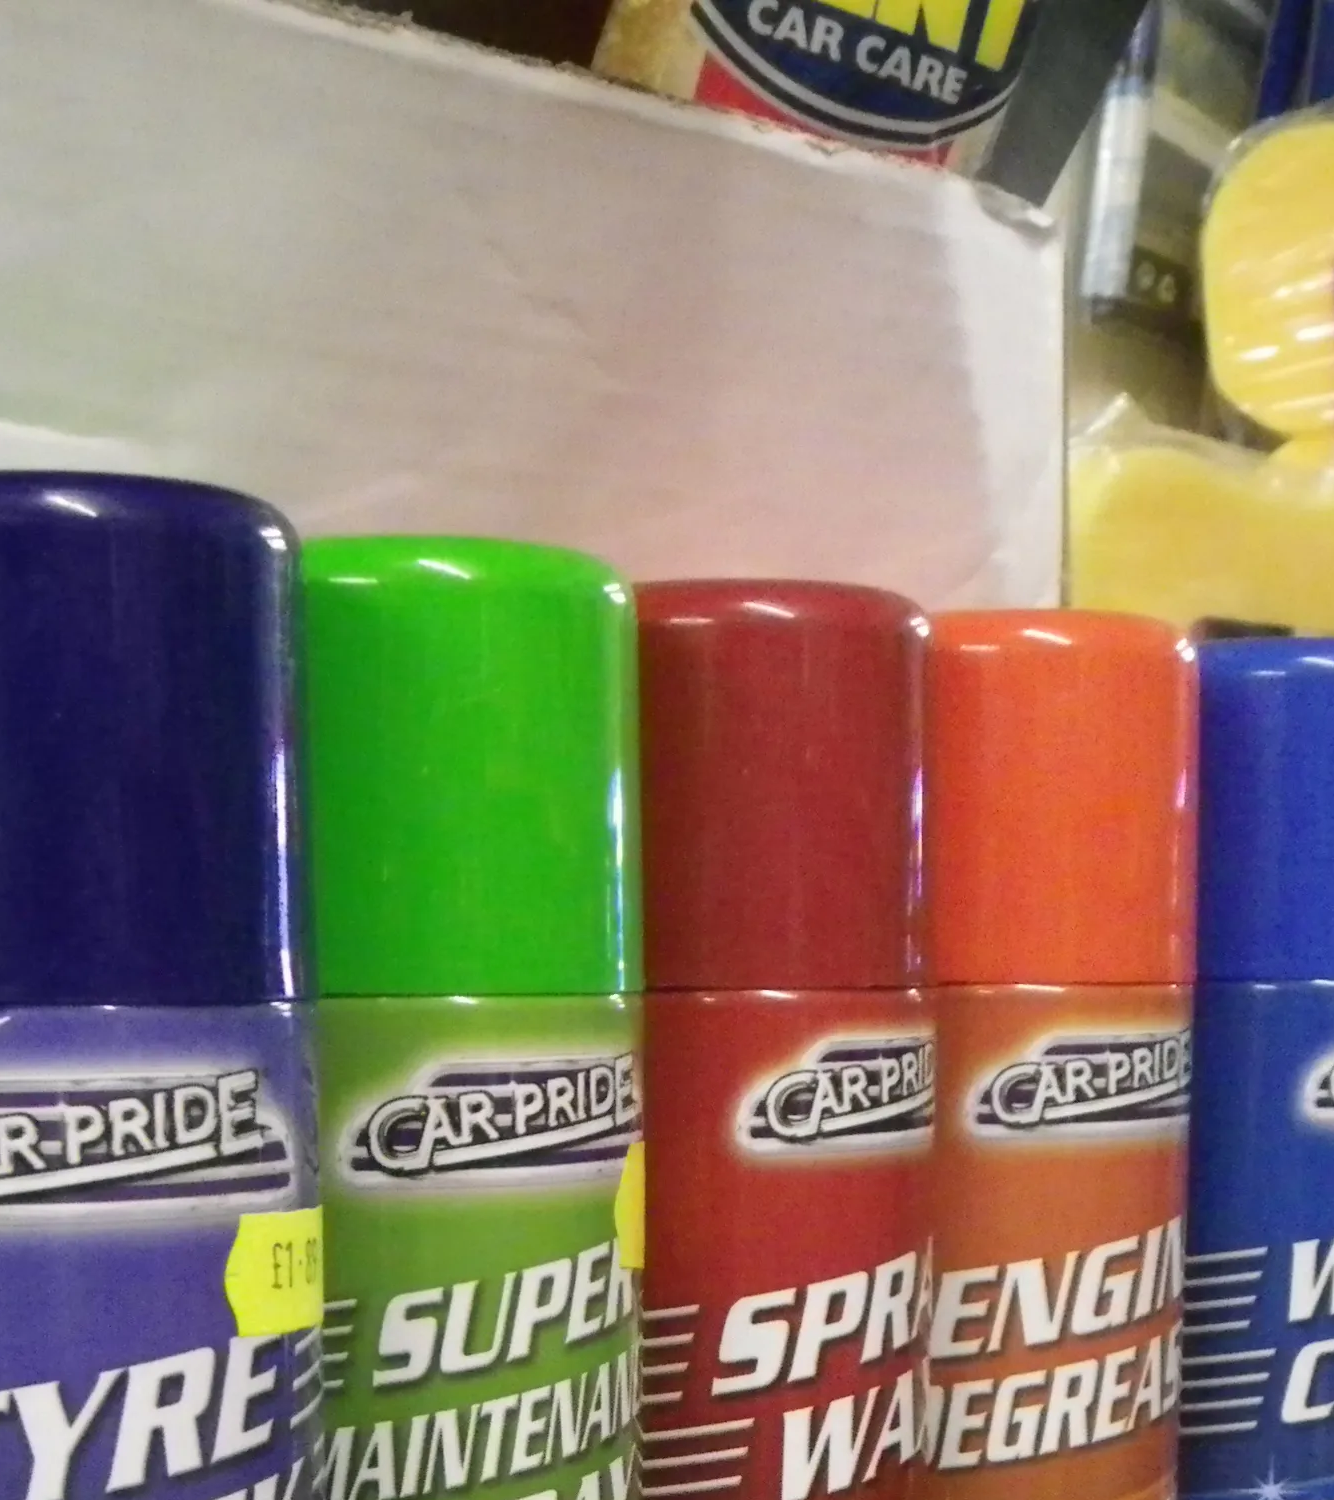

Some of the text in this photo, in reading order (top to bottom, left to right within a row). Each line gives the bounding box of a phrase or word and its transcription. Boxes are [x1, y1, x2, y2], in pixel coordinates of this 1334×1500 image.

[747, 0, 845, 62] CAR
[855, 35, 967, 105] CARE
[368, 1052, 641, 1173] CAR-PRIDE
[371, 1238, 634, 1389] SUPER
